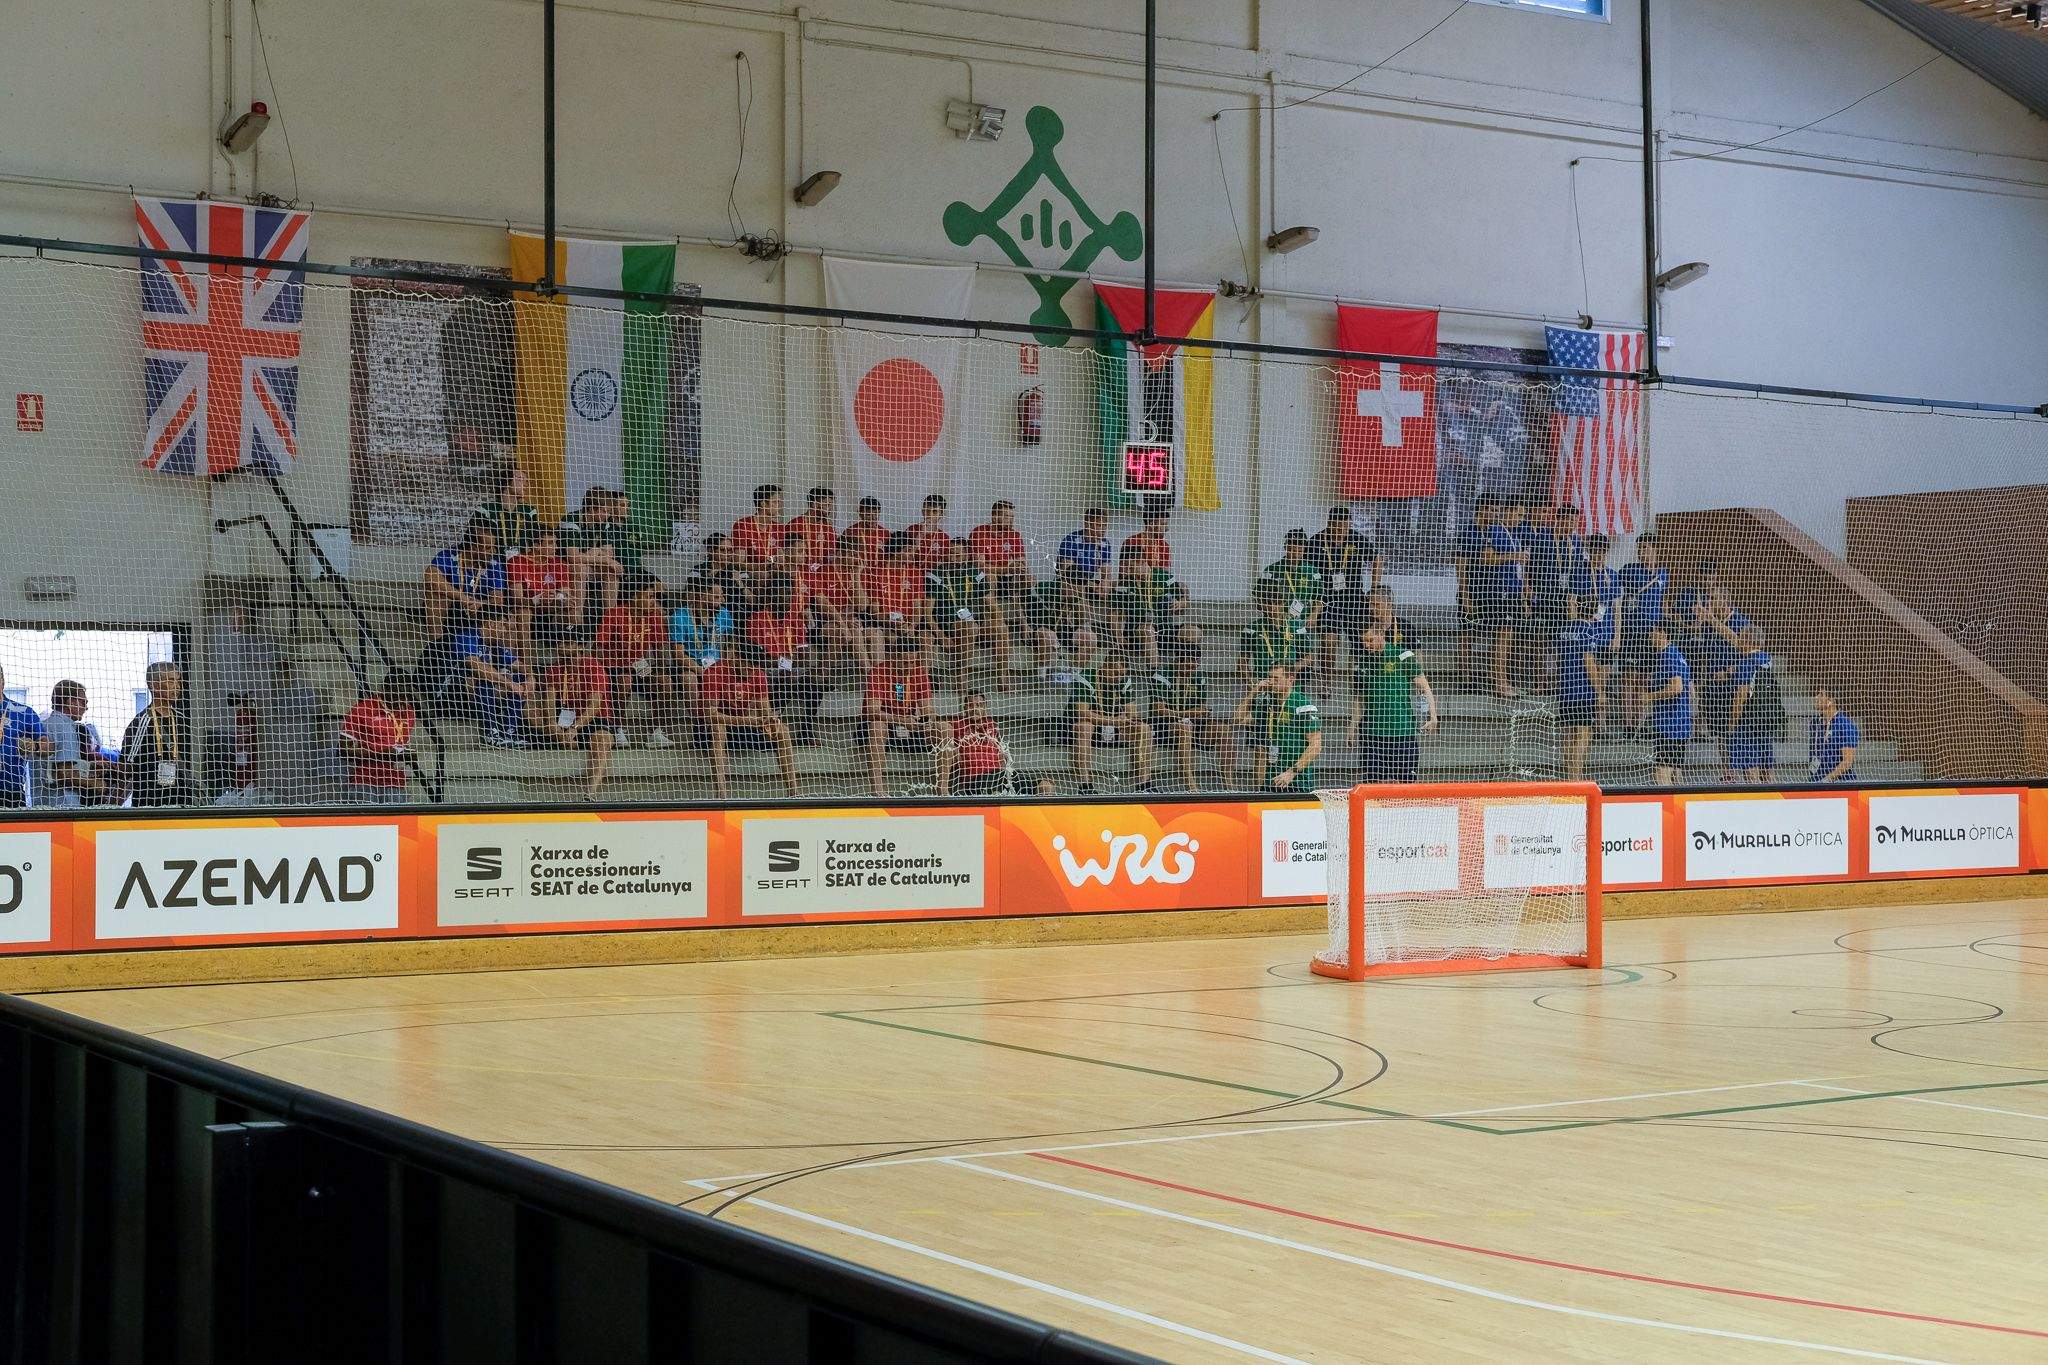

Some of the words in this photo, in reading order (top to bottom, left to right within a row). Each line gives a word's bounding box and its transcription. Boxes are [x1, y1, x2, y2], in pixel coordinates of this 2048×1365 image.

[1126, 452, 1167, 485] 45
[1720, 830, 1791, 849] MURALLA
[1794, 829, 1843, 847] ÒPTICA
[1900, 825, 1966, 842] MURALLA
[530, 846, 583, 861] Xarxa
[587, 845, 609, 860] de
[825, 840, 873, 853] Xarxa
[876, 839, 896, 853] de
[1291, 841, 1328, 851] Generali
[825, 854, 943, 871] Concessionaris
[1291, 853, 1303, 862] de
[1305, 852, 1327, 862] Catal
[530, 861, 661, 878] Concessionaris
[530, 881, 574, 896] SEAT
[577, 880, 599, 895] de
[603, 879, 692, 896] Catalunya
[757, 879, 811, 890] SEAT
[825, 873, 864, 887] SEAT
[867, 872, 887, 886] de
[890, 872, 970, 887] Catalunya
[454, 887, 514, 899] SEAT
